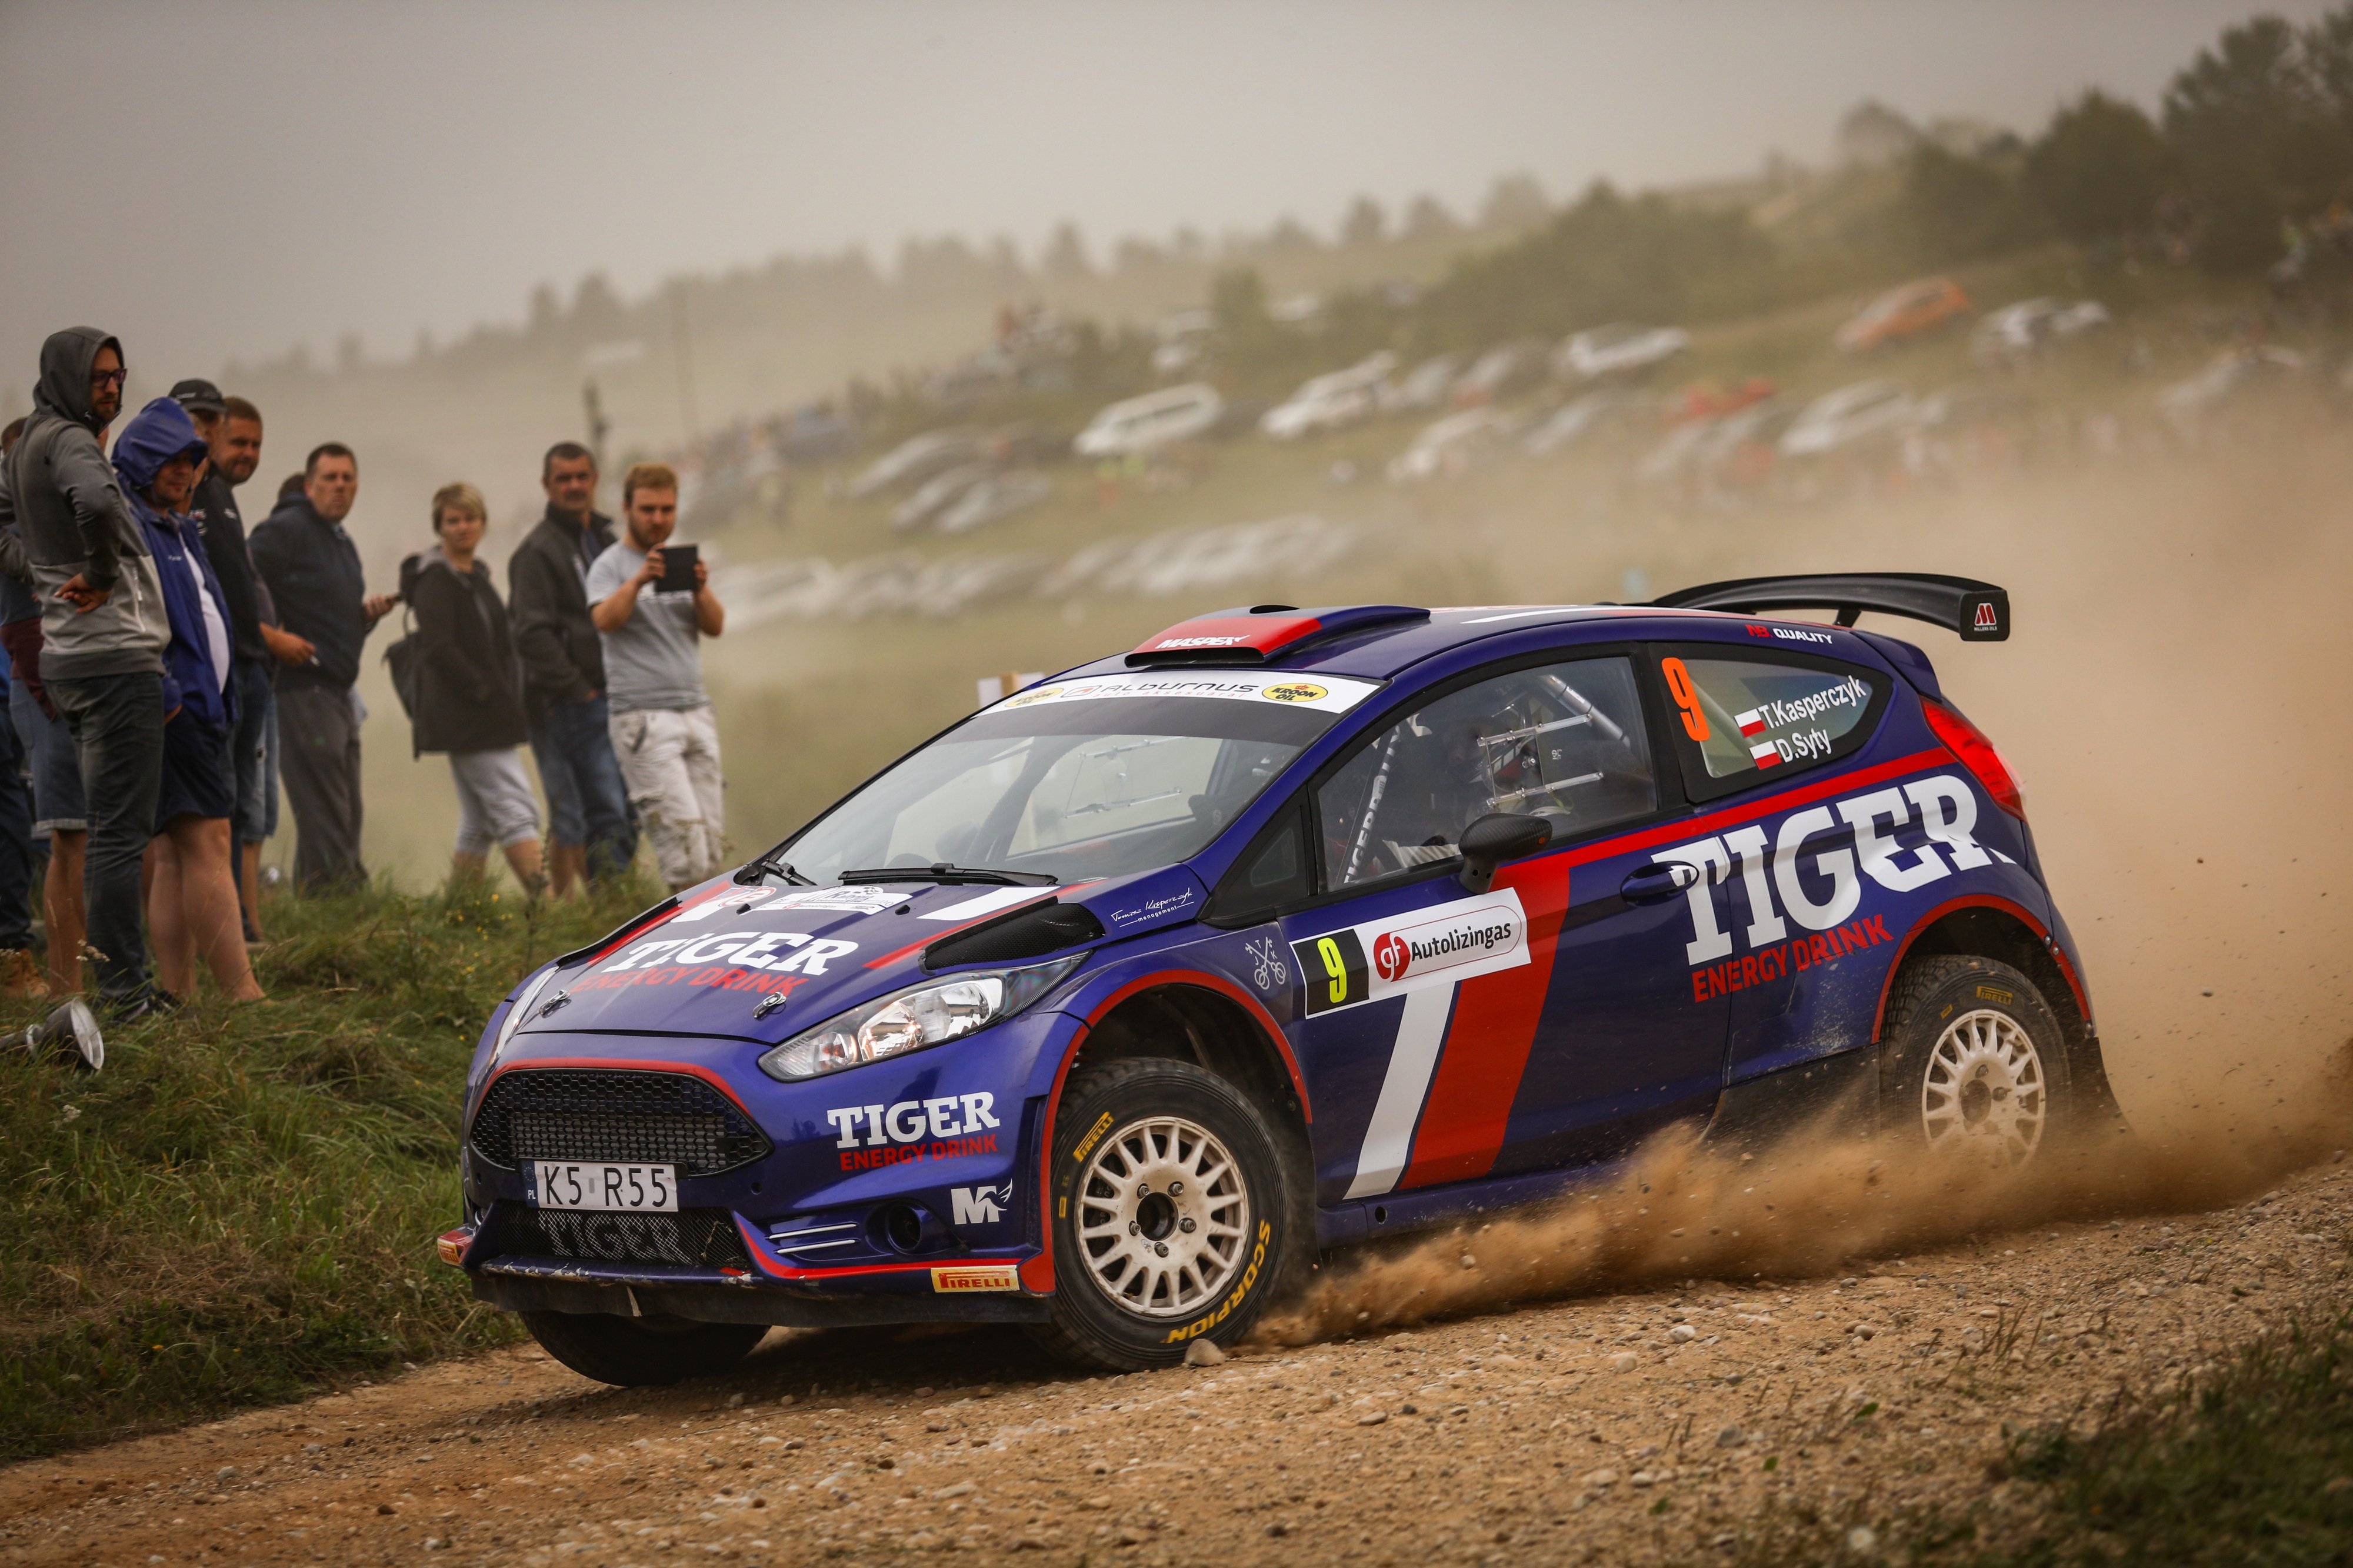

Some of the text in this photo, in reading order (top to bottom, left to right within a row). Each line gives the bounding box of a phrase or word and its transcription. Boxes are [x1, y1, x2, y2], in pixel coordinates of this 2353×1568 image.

[1772, 628, 1832, 644] QUALITY
[1271, 687, 1319, 698] KROON
[1661, 657, 1710, 741] 9
[1758, 675, 1867, 729] T.Kasperczyk
[1775, 728, 1832, 763] D.Syty
[1650, 775, 2017, 966] TIGER
[601, 932, 859, 976] TIGER
[1411, 922, 1512, 962] Autolizingas
[1692, 914, 1894, 1003] ENERGY DRINK
[569, 968, 809, 997] ENERGY DRINK
[1317, 938, 1347, 1003] 9
[1976, 985, 2013, 1005] PIRELLI
[827, 1092, 1000, 1149] TIGER
[1073, 1111, 1115, 1163] PIRELLI
[839, 1134, 998, 1171] ENERGY DRINK
[528, 1189, 536, 1200] PL
[544, 1166, 667, 1207] K5 R55
[538, 1210, 693, 1265] TIGER
[938, 1270, 1011, 1289] PIRELLI
[1166, 1219, 1271, 1343] SCORPION
